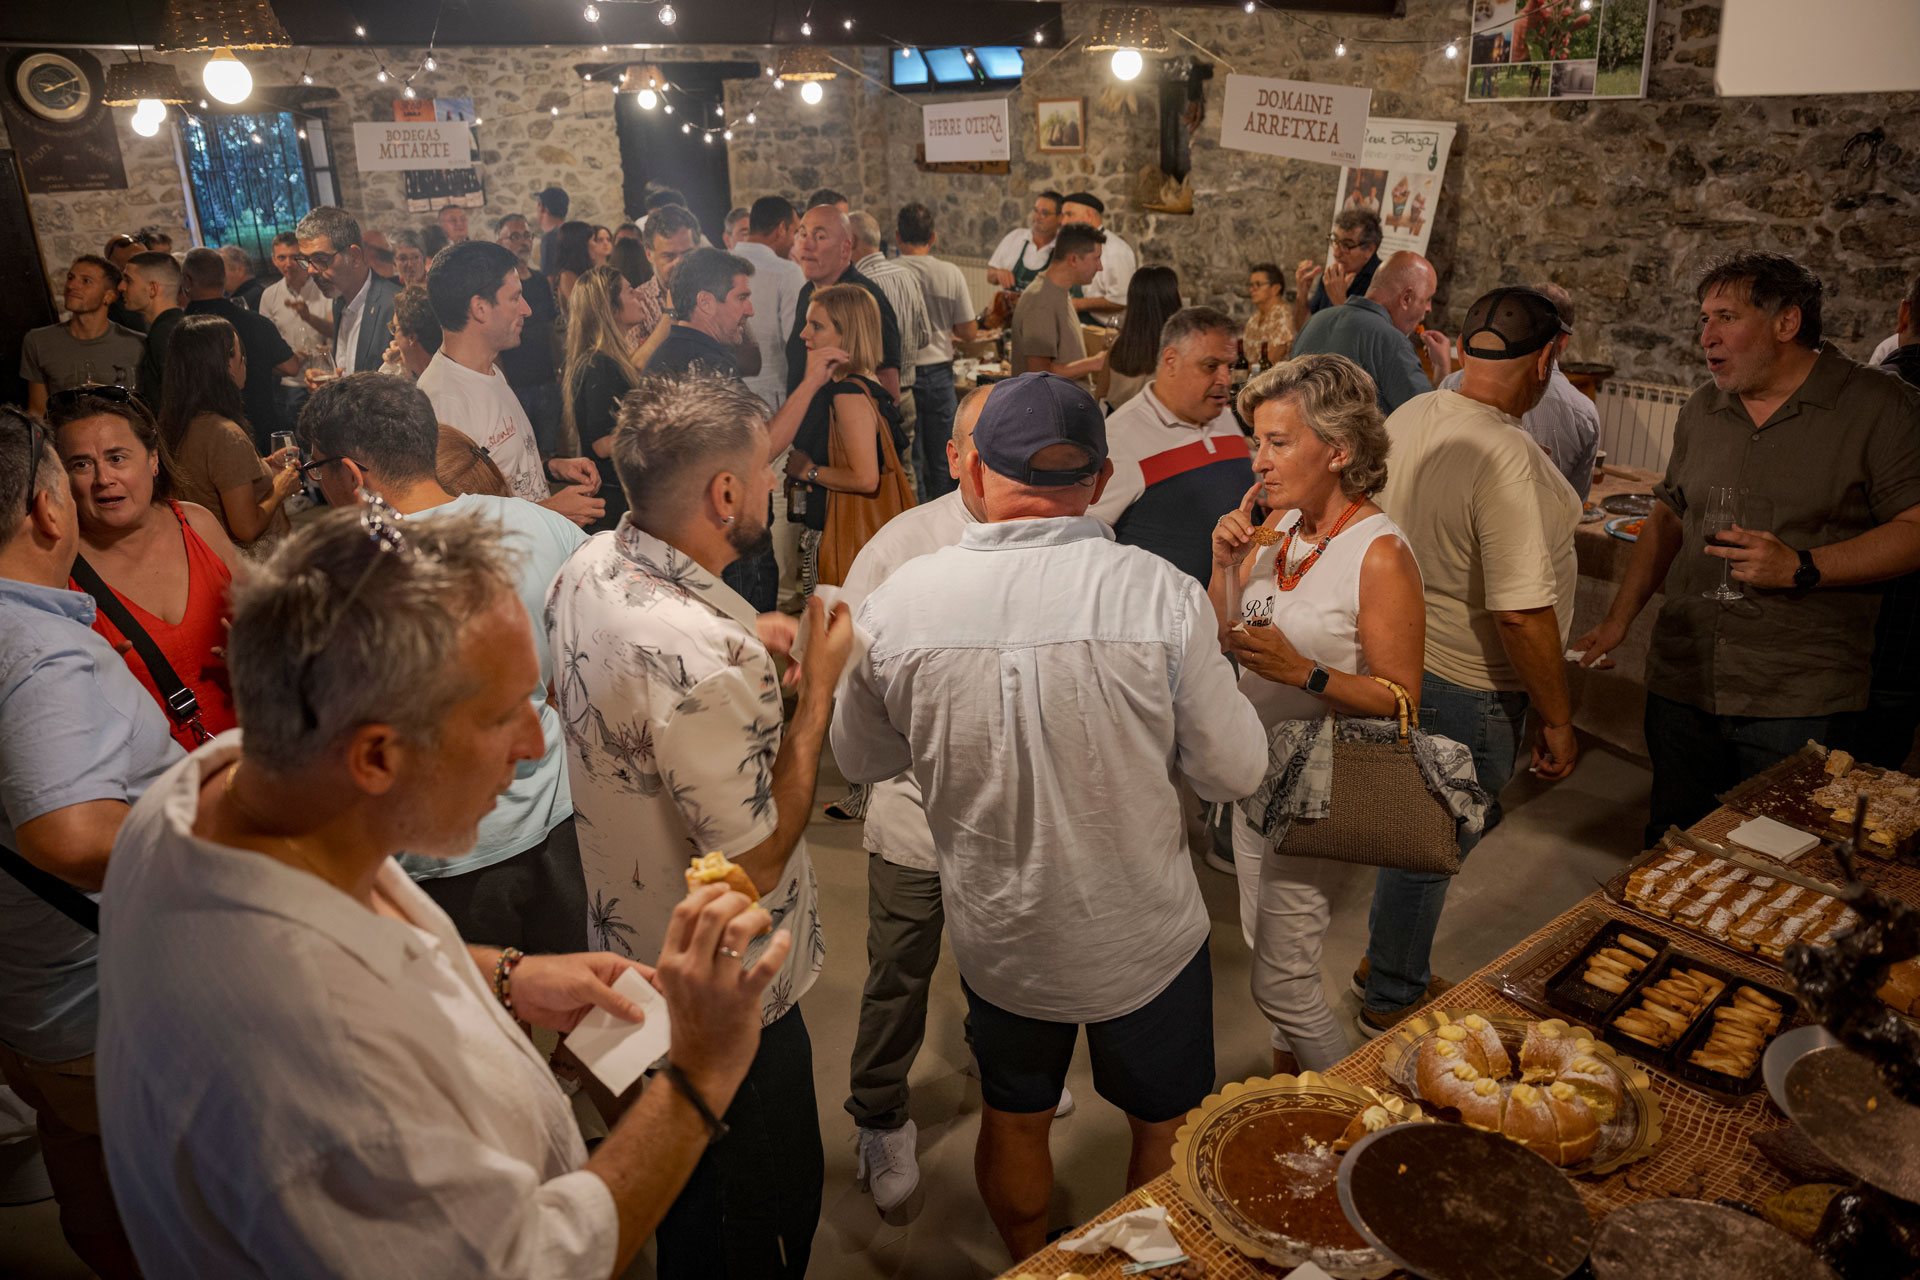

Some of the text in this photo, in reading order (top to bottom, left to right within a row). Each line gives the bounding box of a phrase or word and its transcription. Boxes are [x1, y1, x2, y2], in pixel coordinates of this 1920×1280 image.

[1256, 89, 1334, 115] DOMAINE
[386, 129, 441, 142] BODEGAS
[929, 115, 1002, 142] PIERRE OTEIZA
[1244, 112, 1340, 144] ARRETXEA
[379, 143, 450, 159] MITARTE
